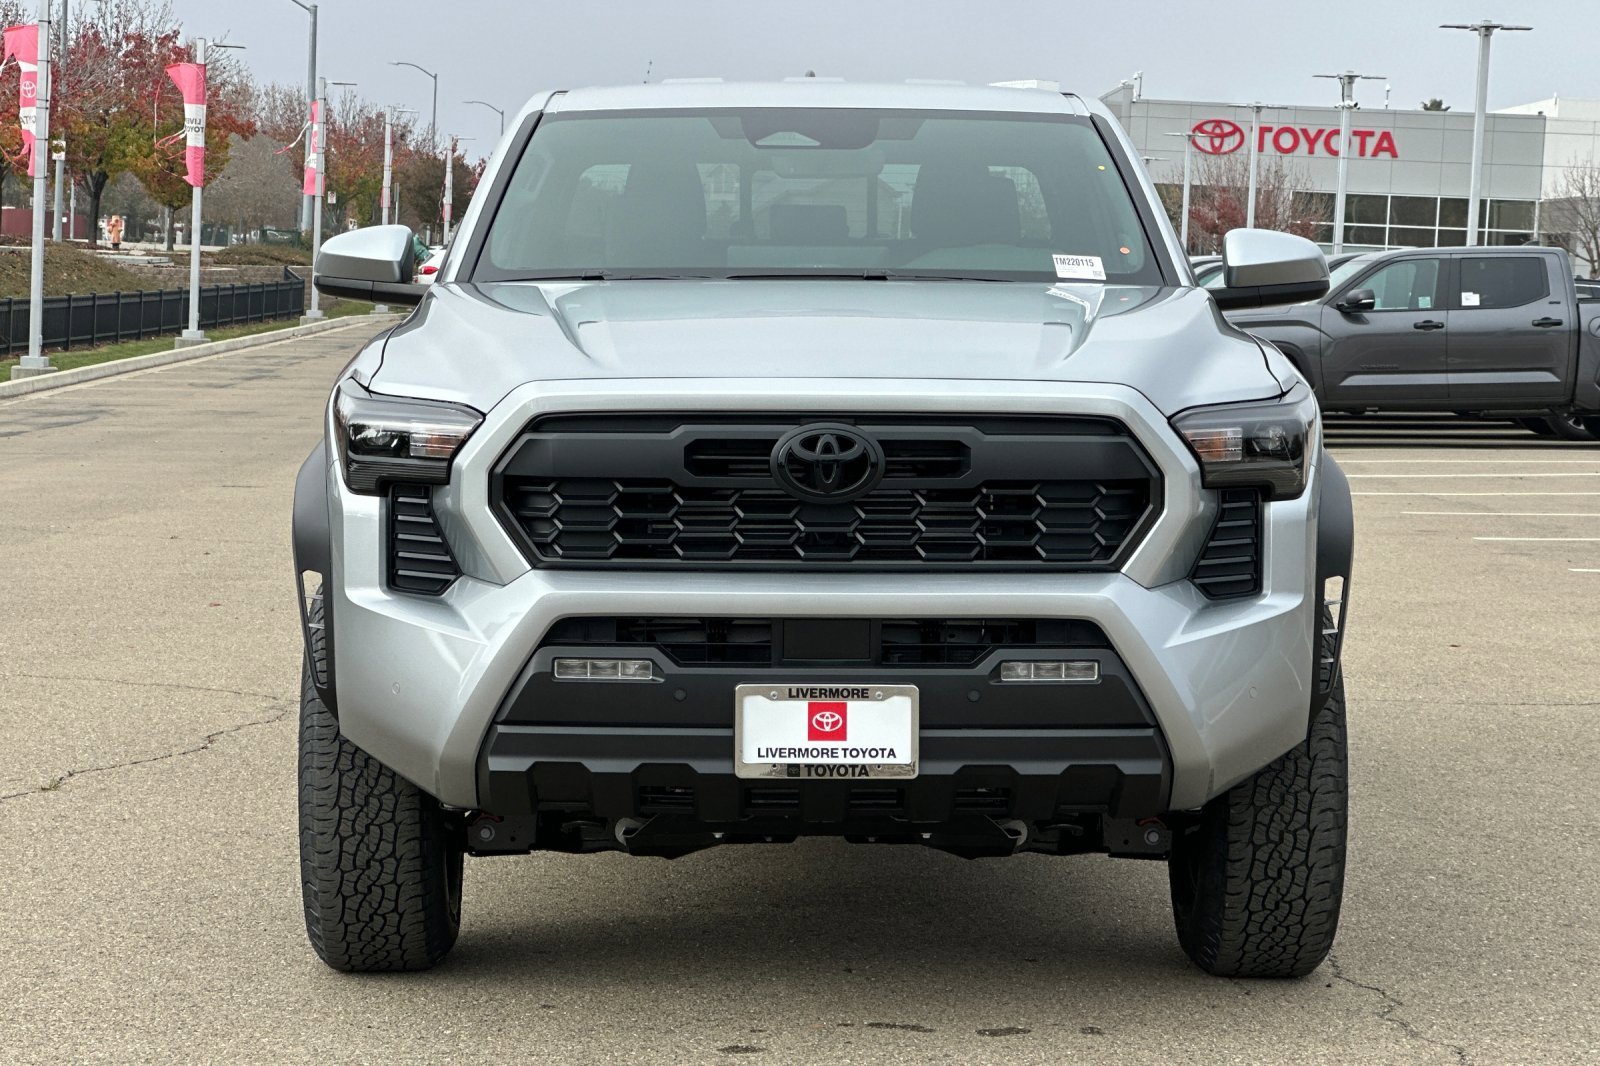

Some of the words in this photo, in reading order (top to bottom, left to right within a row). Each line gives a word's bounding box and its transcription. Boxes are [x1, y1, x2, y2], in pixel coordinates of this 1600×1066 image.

[1251, 126, 1398, 158] TOYOTA
[1054, 257, 1094, 267] TM220115
[788, 688, 869, 699] LIVERMORE
[757, 747, 839, 759] LIVERMORE
[841, 747, 897, 759] TOYOTA
[804, 764, 869, 777] TOYOTA
